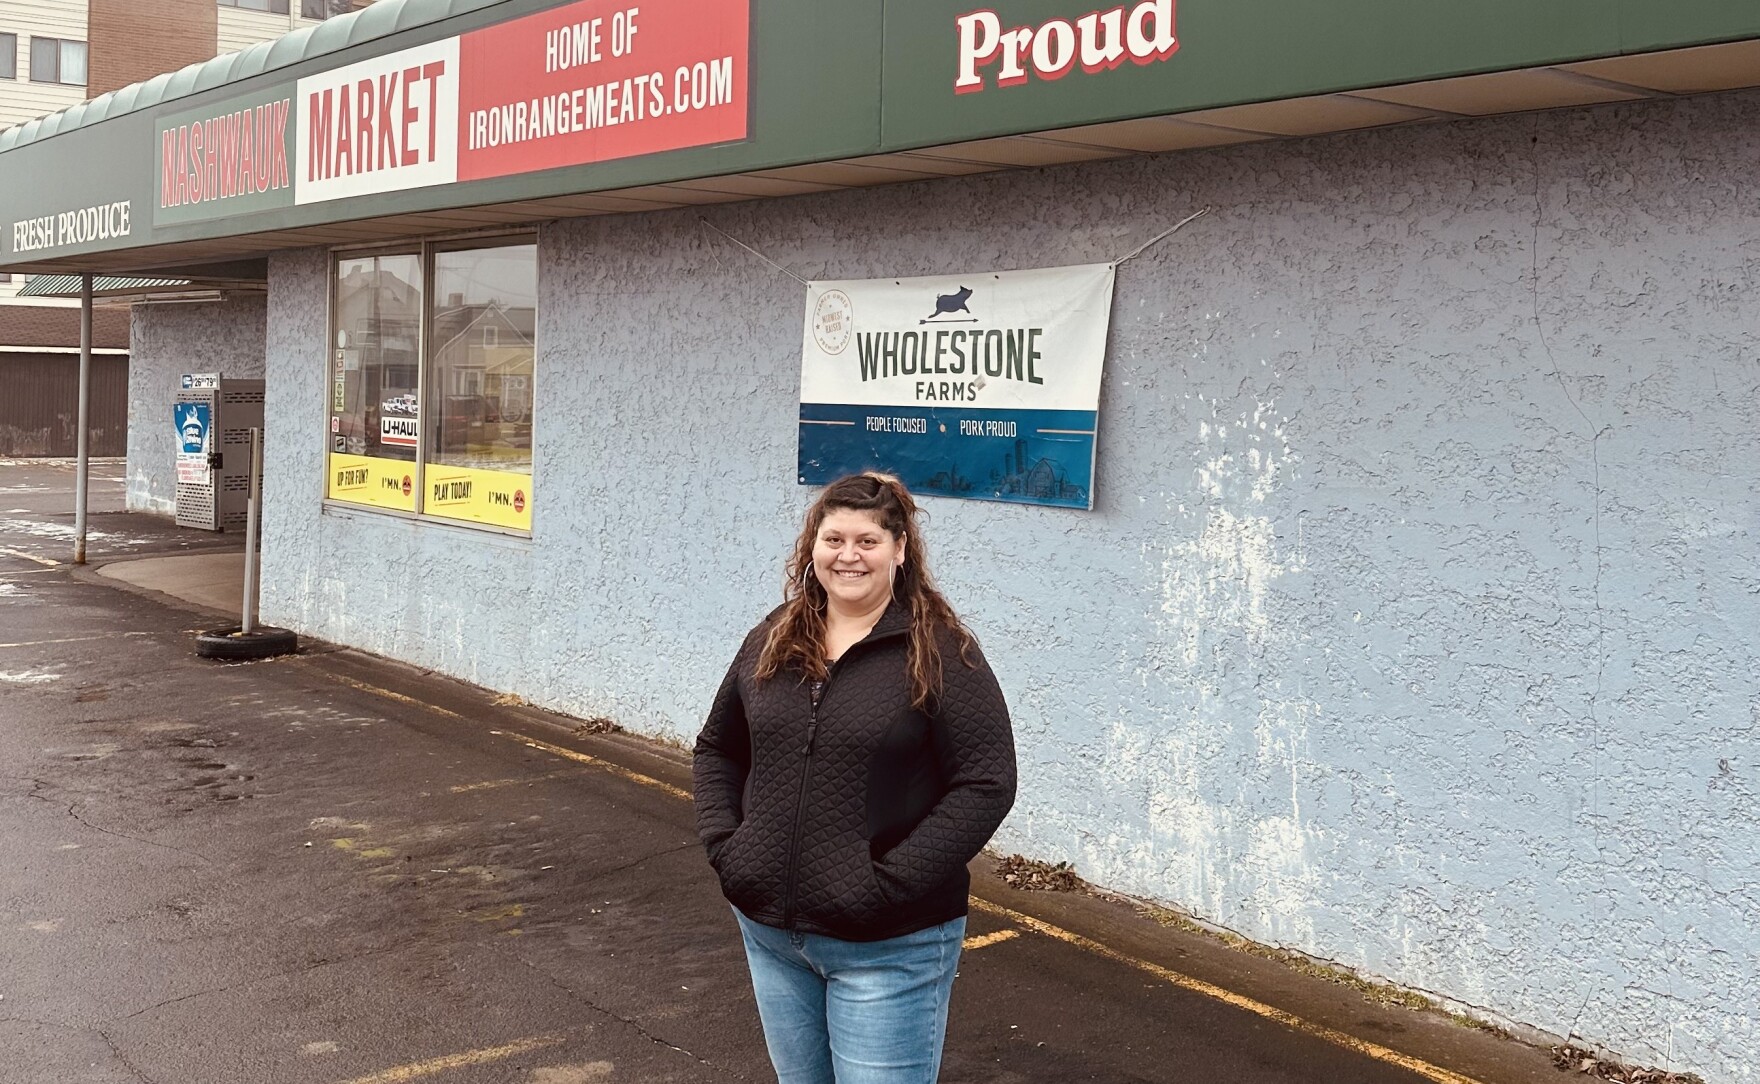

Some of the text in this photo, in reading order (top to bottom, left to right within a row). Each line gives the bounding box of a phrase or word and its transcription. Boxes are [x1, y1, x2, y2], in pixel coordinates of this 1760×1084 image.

[545, 8, 639, 73] HOME OF
[954, 0, 1180, 95] Proud
[469, 57, 732, 150] IRONRANGEMEATS.COM
[161, 60, 445, 208] NASHWAUK MARKET
[13, 200, 131, 252] FRESH PRODUCE
[857, 328, 1043, 385] WHOLESTONE
[915, 381, 977, 401] FARMS
[382, 420, 418, 436] U-HAUL
[866, 416, 927, 434] PEOPLE FOCUSED
[960, 420, 1017, 438] PORK PROUD
[337, 468, 369, 487] UP FOR FUN?
[433, 481, 472, 502] PLAY TODAY!
